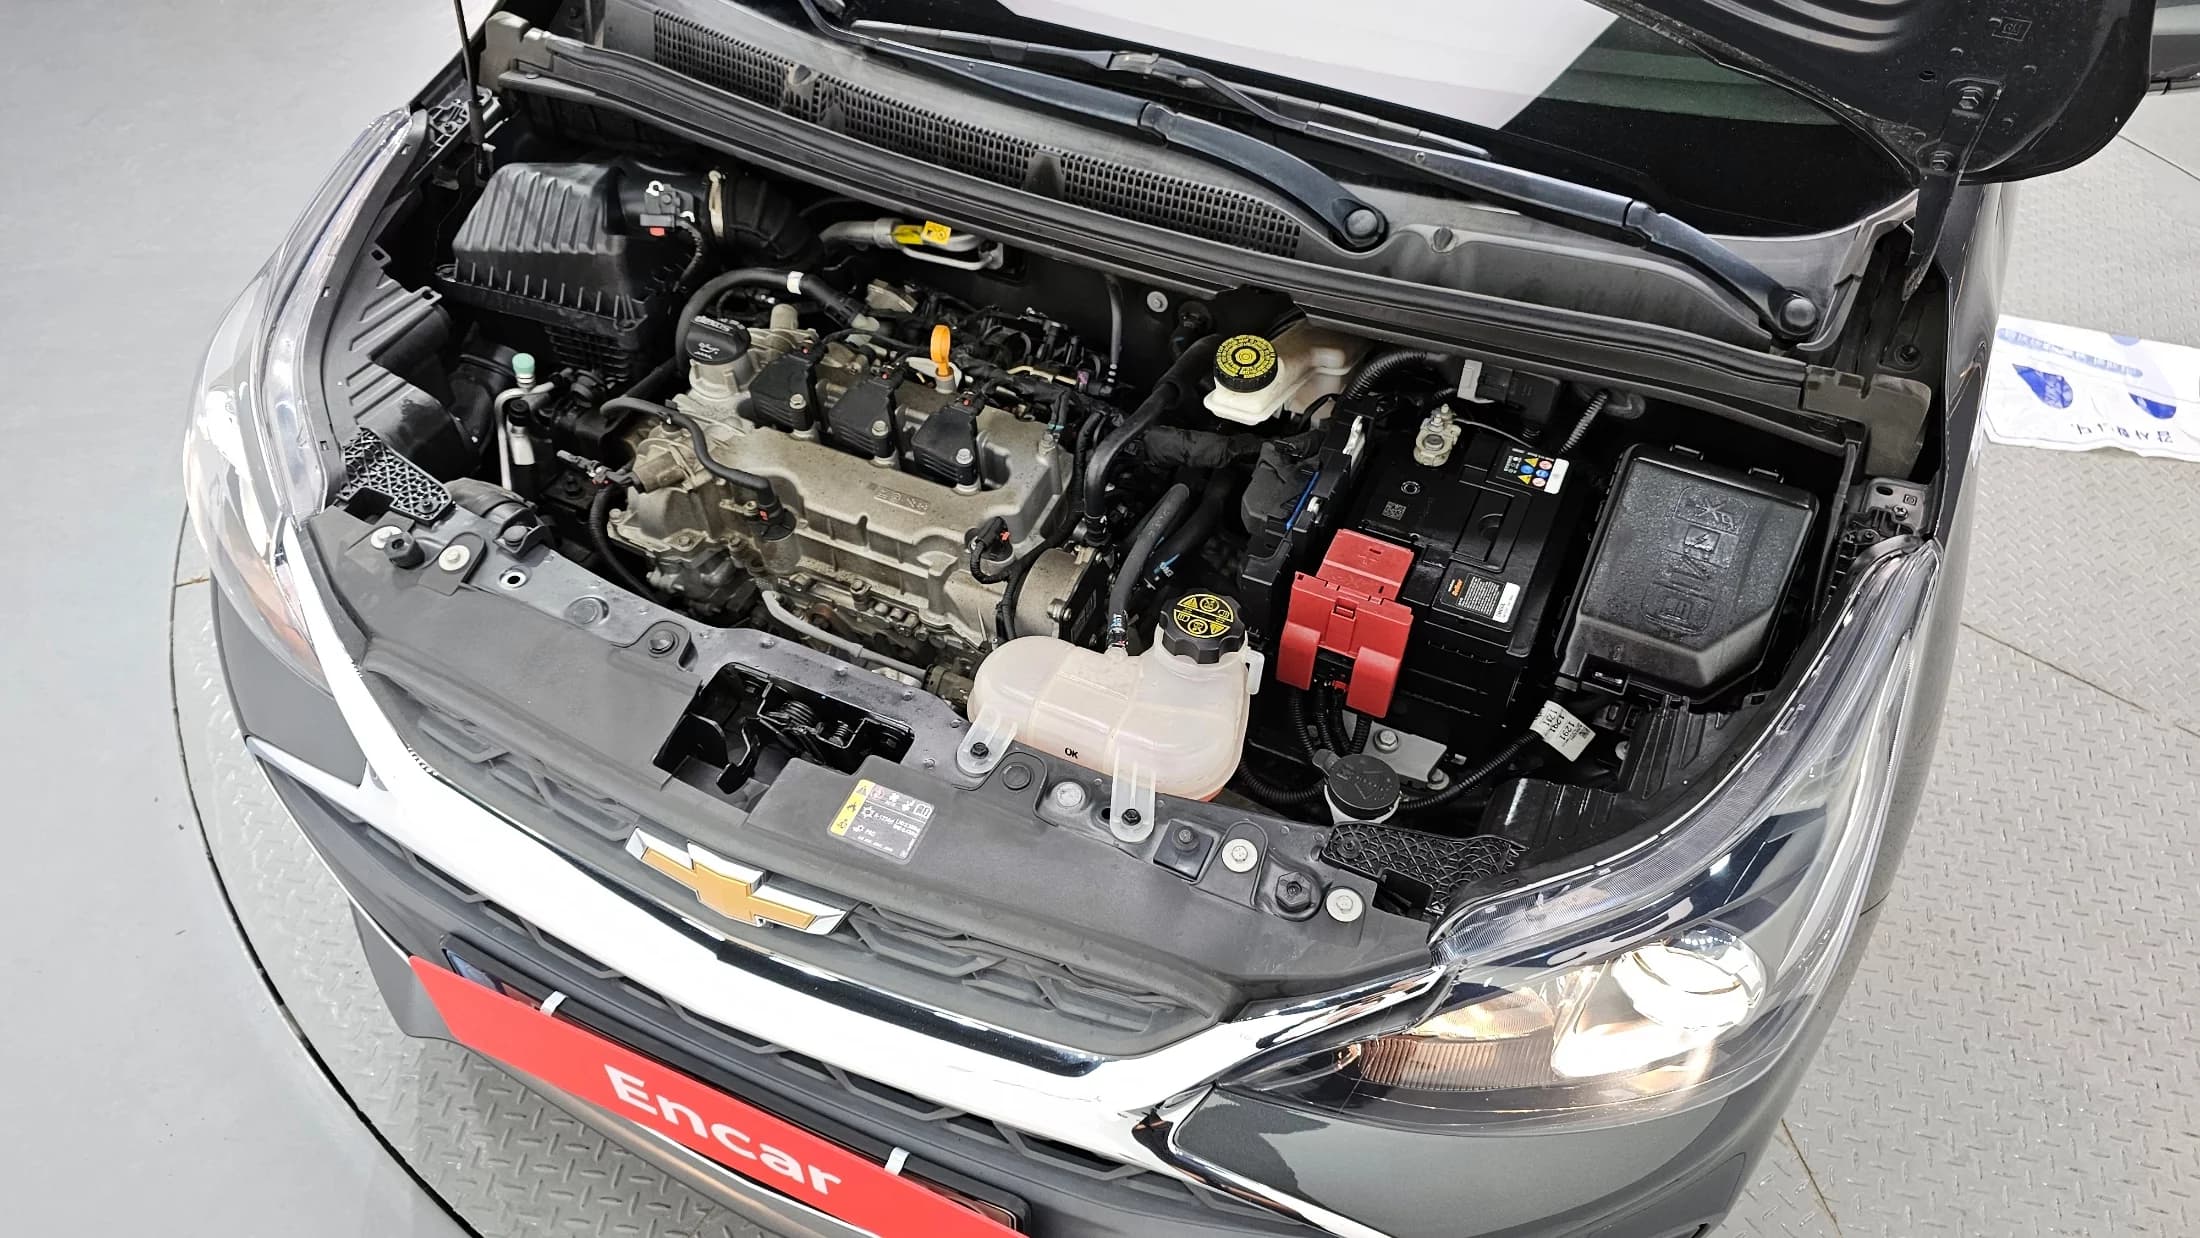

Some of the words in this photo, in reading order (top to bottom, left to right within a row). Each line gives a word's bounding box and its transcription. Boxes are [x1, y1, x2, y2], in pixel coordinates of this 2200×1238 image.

[1559, 721, 1575, 741] 1291
[1065, 747, 1078, 759] OK
[604, 1064, 842, 1195] Encar
